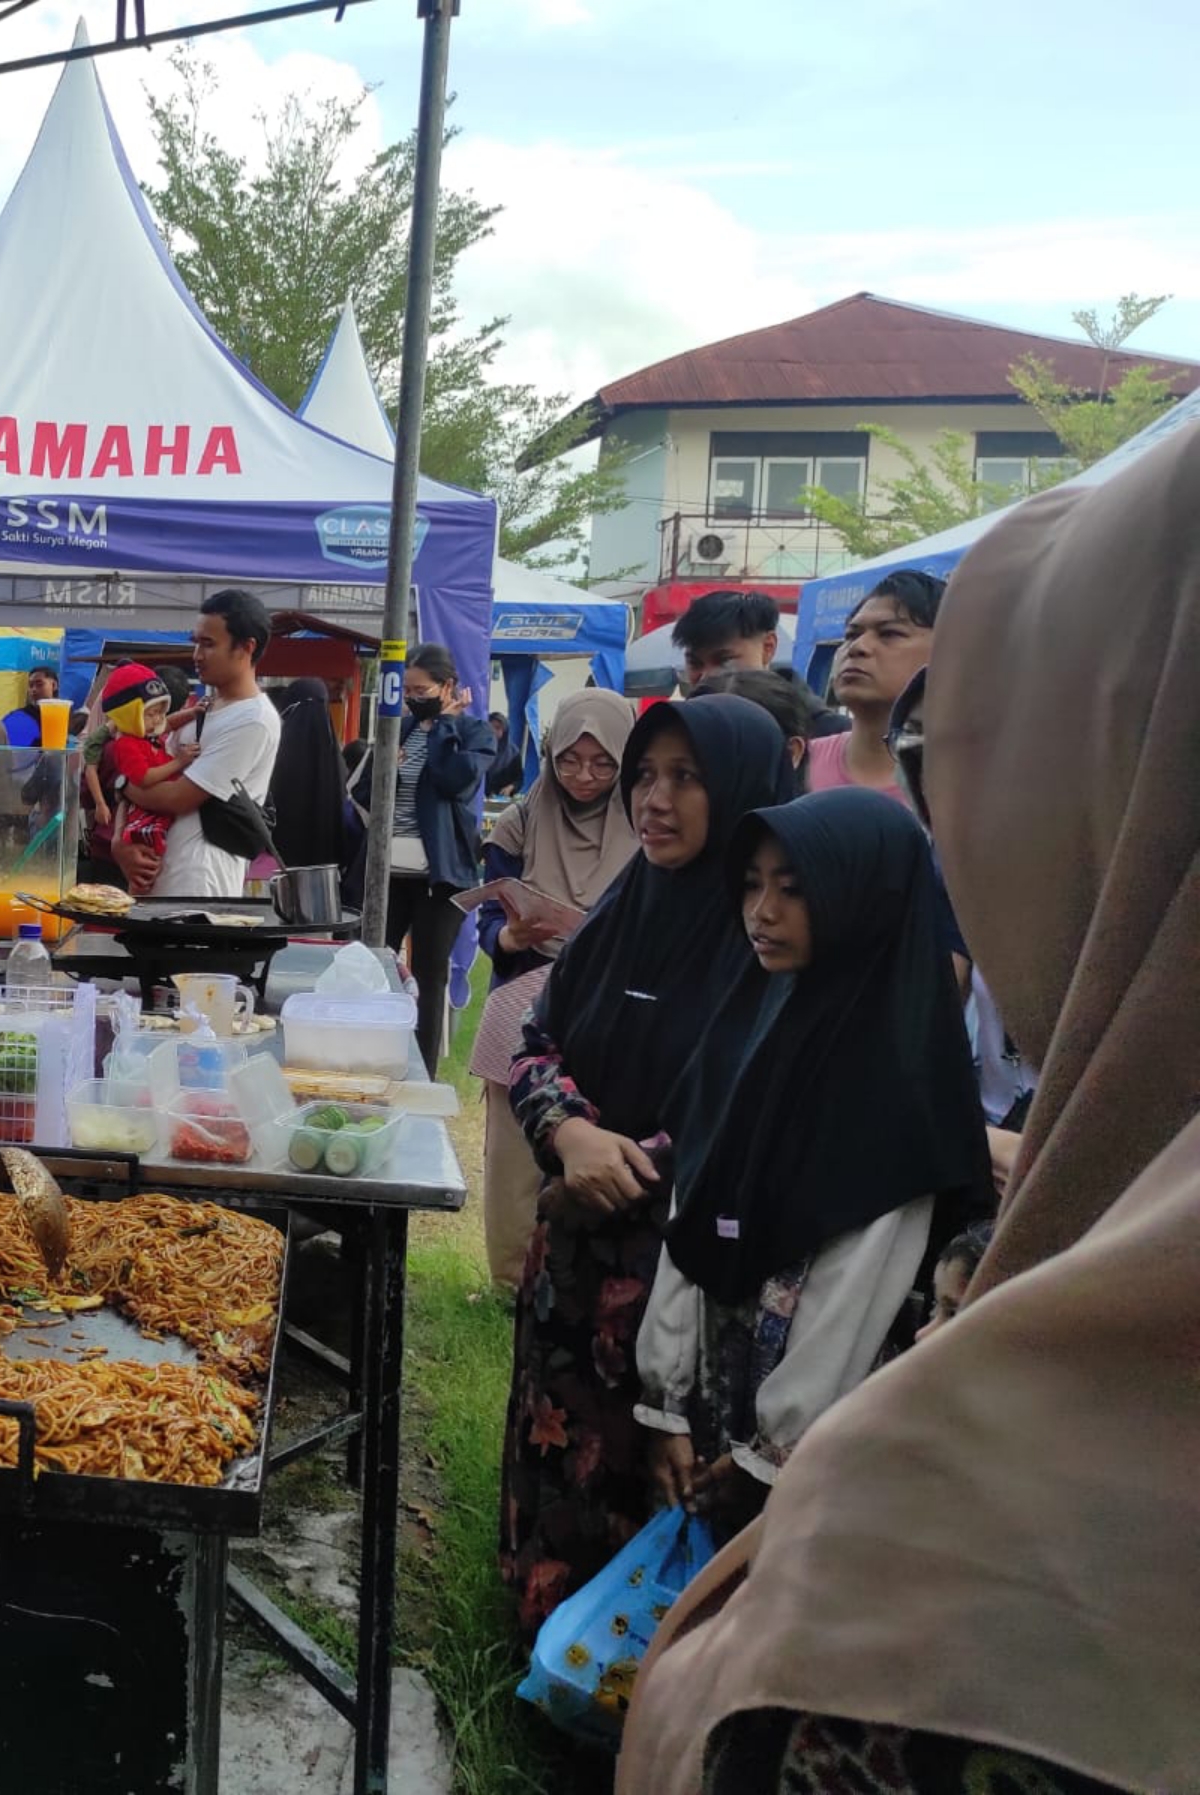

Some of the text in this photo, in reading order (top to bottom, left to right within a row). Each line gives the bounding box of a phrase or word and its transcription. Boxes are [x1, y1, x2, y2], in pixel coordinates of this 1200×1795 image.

[323, 517, 420, 536] CLAS
[2, 530, 29, 543] Sakti
[33, 532, 65, 547] Surya
[68, 535, 107, 550] Megah
[378, 671, 401, 705] C
